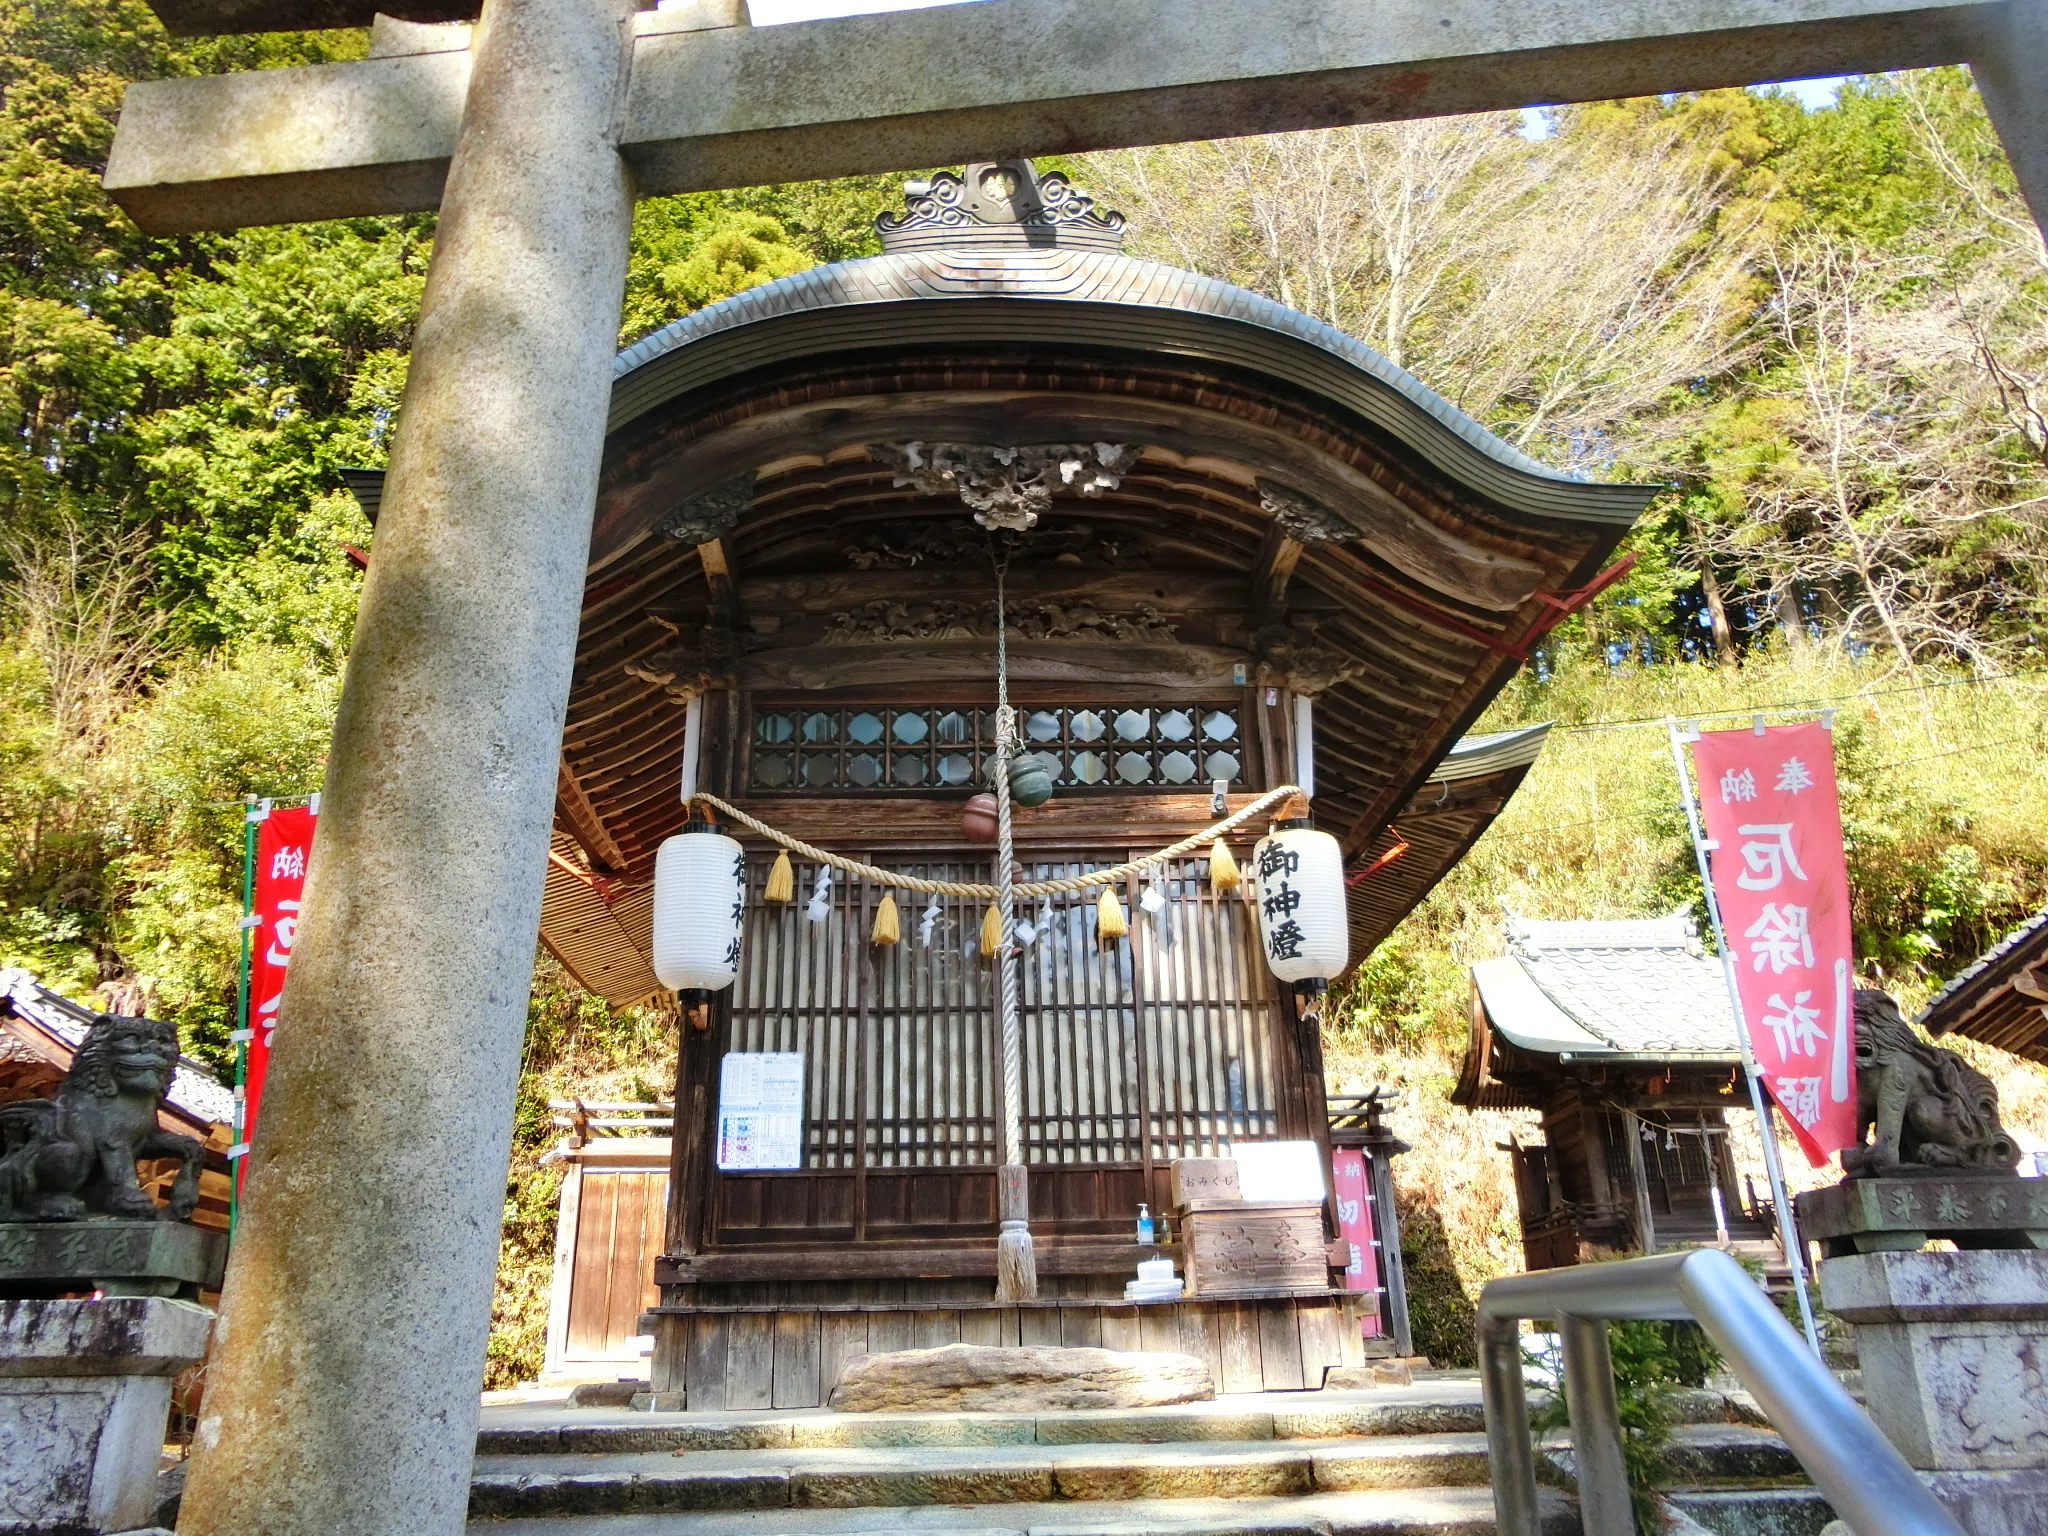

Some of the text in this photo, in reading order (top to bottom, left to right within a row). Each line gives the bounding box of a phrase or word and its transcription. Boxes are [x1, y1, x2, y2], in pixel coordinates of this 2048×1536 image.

[1257, 838, 1306, 961] 御神燈
[1184, 1175, 1235, 1188] おみくじ
